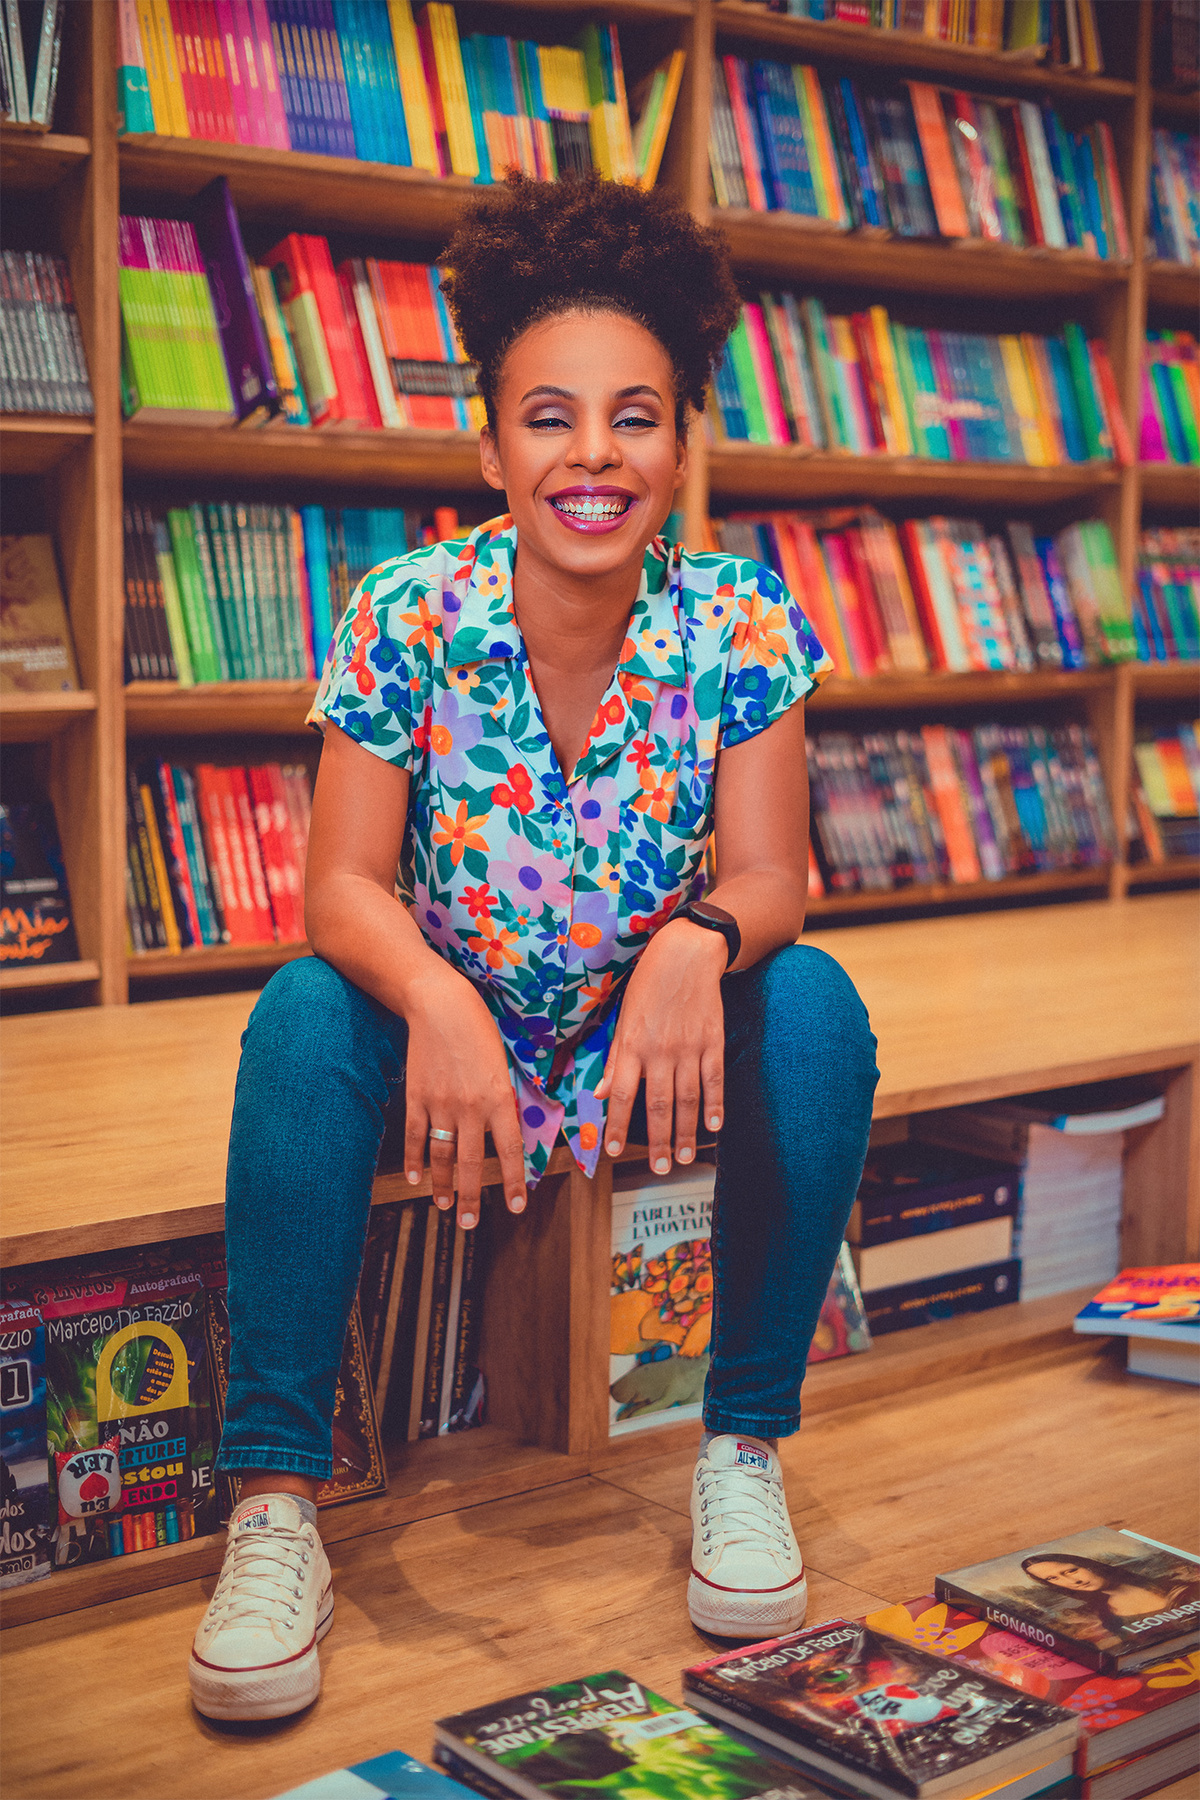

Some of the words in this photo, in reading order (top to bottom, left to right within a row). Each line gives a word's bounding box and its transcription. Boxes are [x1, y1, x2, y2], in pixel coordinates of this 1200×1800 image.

[633, 1226, 650, 1240] LA
[130, 1273, 201, 1295] Autografado
[0, 1307, 41, 1325] rafado
[48, 1314, 113, 1344] Marcelo
[118, 1308, 141, 1331] De
[144, 1300, 192, 1324] Fazzio
[6, 1367, 24, 1402] 1
[119, 1418, 169, 1446] NÃO
[67, 1453, 115, 1480] LER
[119, 1439, 186, 1467] ERTURBE
[737, 1451, 749, 1465] ALL
[124, 1483, 177, 1508] ENDO
[252, 1512, 269, 1527] STAR
[986, 1606, 1055, 1648] LEONARDO
[715, 1653, 788, 1683] Marcelo
[780, 1644, 814, 1661] De
[804, 1627, 860, 1652] Fazzio
[599, 1682, 647, 1708] A
[476, 1684, 599, 1734] perfeita
[477, 1702, 646, 1755] TEMPESTADE
